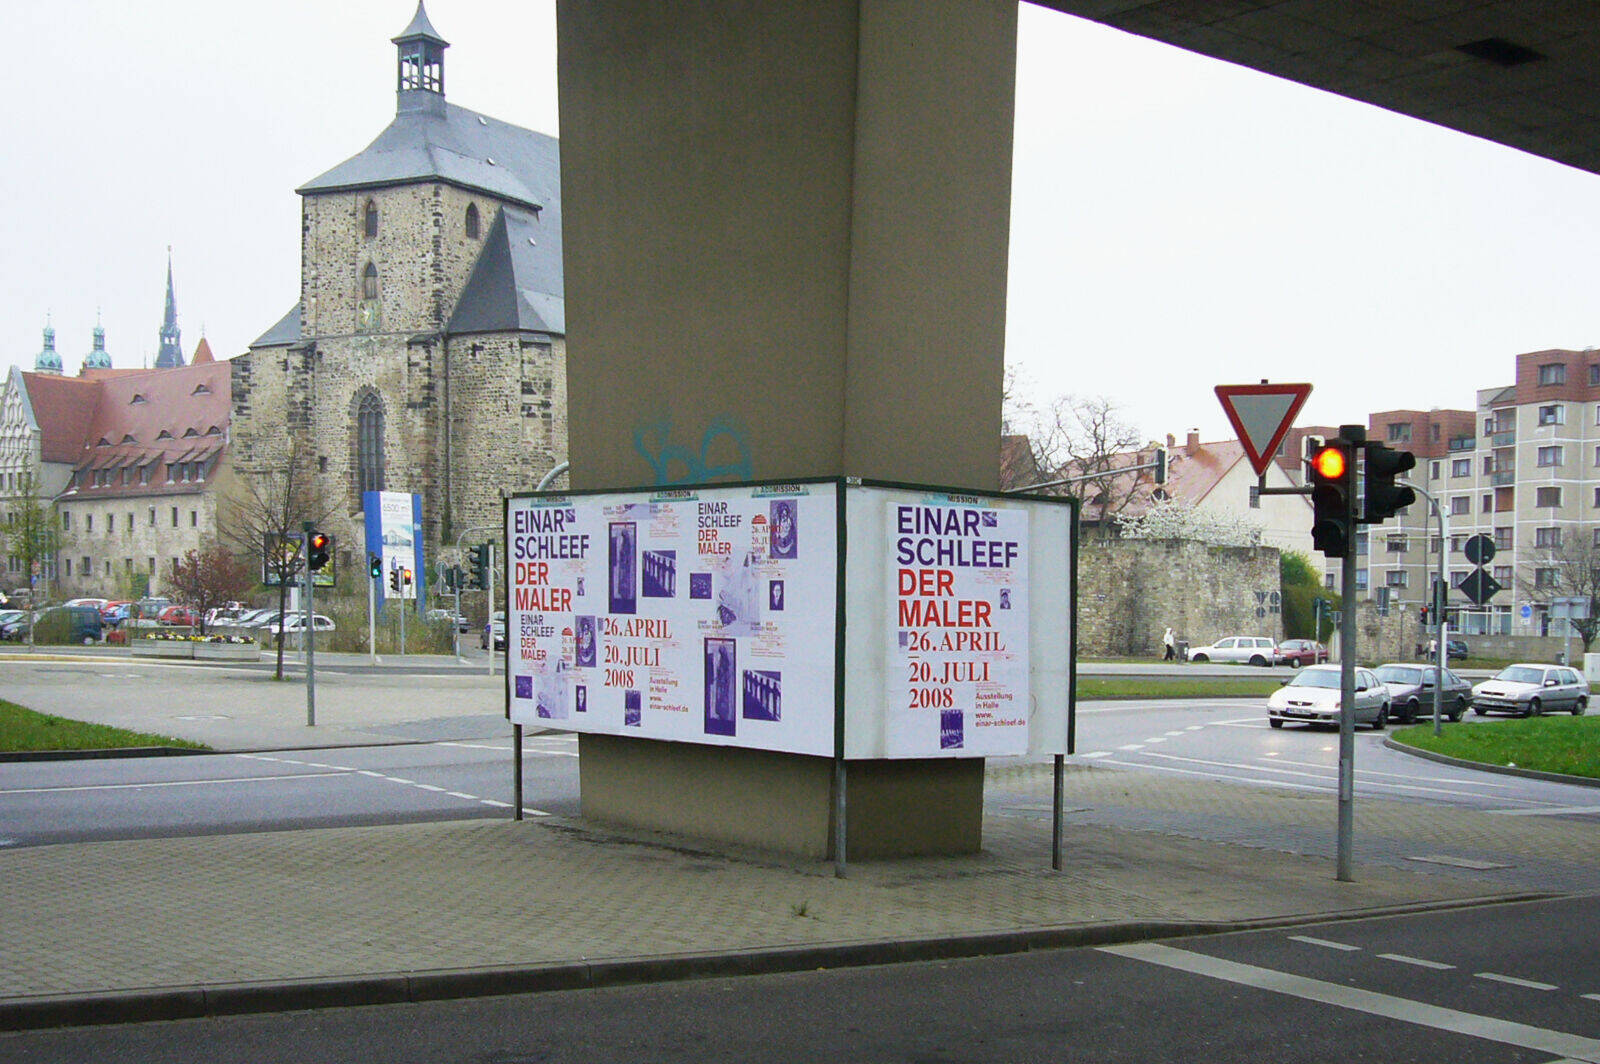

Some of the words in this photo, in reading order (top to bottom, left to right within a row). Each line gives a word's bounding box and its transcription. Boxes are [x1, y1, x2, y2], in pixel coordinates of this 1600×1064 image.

[698, 502, 728, 515] EINAR
[514, 509, 565, 534] EINAR
[698, 515, 742, 528] SCHLEEF
[898, 506, 980, 537] EINAR
[698, 529, 718, 541] DER
[514, 535, 590, 559] SCHLEEF
[698, 542, 732, 555] MALER
[897, 537, 1018, 568] SCHLEEF
[515, 562, 549, 585] DER
[898, 569, 954, 597] DER
[515, 588, 572, 612] MALER
[520, 614, 544, 625] EINAR
[898, 599, 992, 628] MALER
[520, 626, 555, 637] SCHLEEF
[520, 637, 537, 648] DER
[520, 649, 547, 660] MALER
[604, 668, 635, 689] 2008
[908, 687, 954, 708] 2008
[975, 692, 1013, 701] Ausstellung
